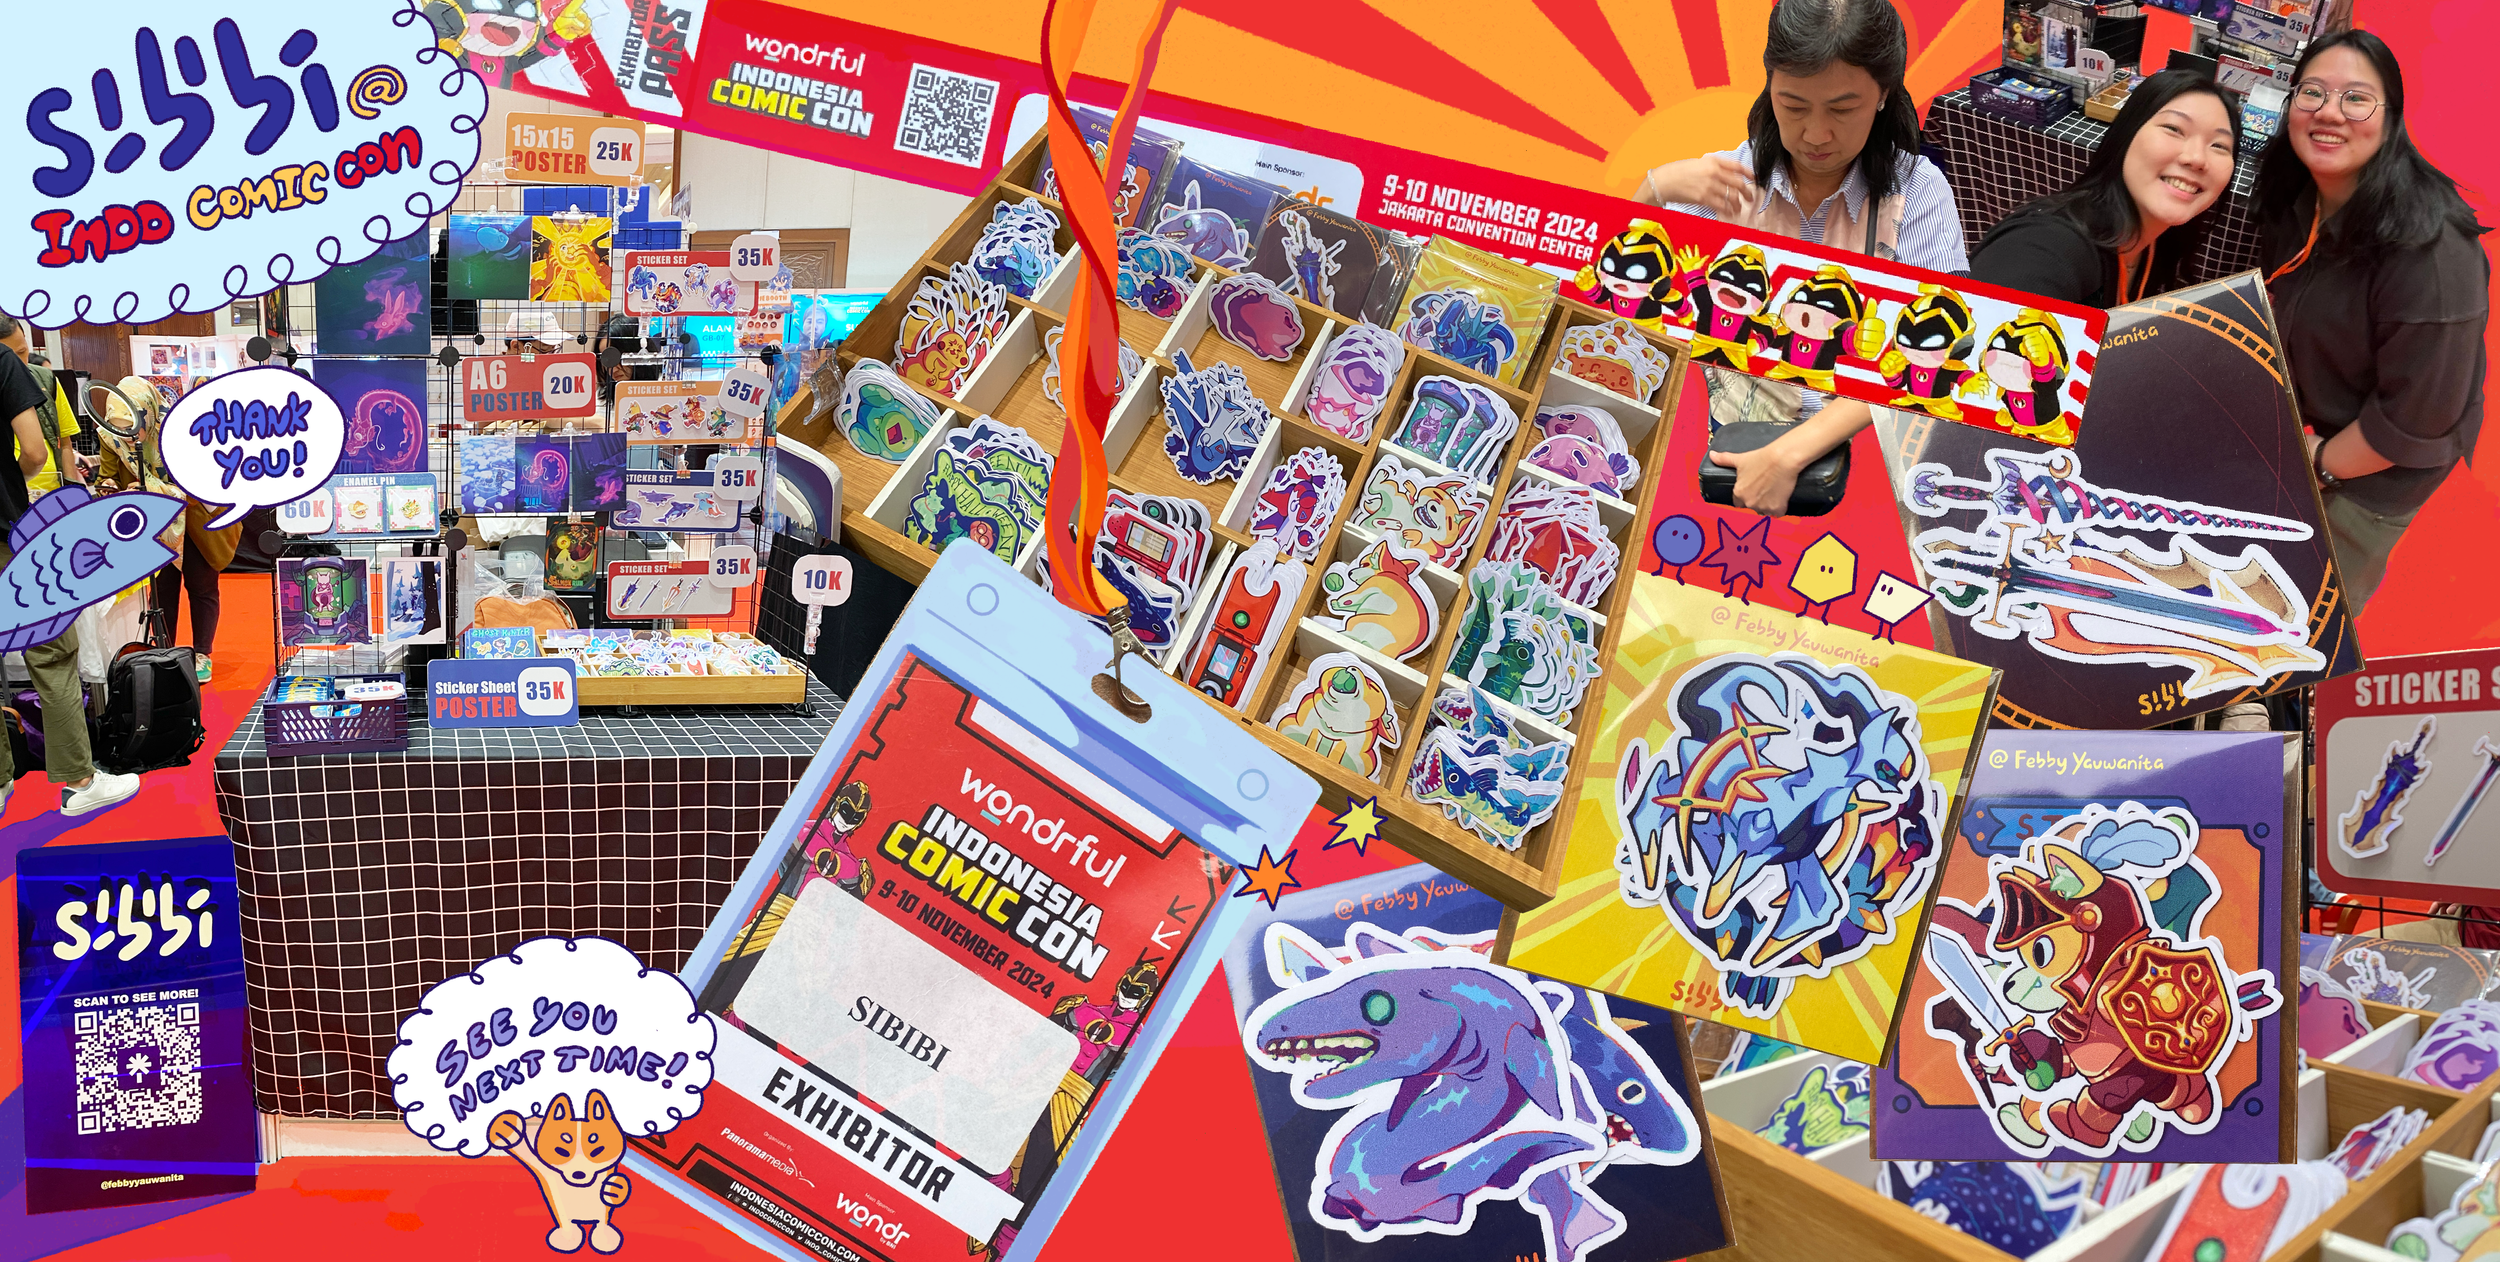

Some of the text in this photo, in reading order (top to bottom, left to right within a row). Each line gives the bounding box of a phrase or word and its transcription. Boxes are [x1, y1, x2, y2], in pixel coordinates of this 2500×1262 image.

[2289, 20, 2310, 34] 35K
[615, 0, 651, 89] EXHIBITOR
[639, 4, 692, 98] PASS
[745, 33, 866, 77] wondrful
[2082, 57, 2104, 71] 10K
[732, 62, 863, 110] INDONESIA
[2276, 70, 2293, 83] 35
[711, 78, 874, 137] COMIC CON
[511, 123, 575, 150] 15x15
[515, 150, 587, 175] POSTER
[596, 141, 633, 162] 25K
[1255, 160, 1305, 178] Main Sponsor:
[1383, 174, 1599, 243] 9-10 NOVEMBER 2024
[1378, 199, 1594, 262] JAKARTA CONVENTION CENTER
[637, 255, 688, 265] STICKER SET
[738, 248, 774, 267] 35K
[703, 325, 732, 333] ALAN
[470, 360, 507, 391] A6
[550, 375, 585, 395] 20K
[471, 391, 543, 413] POSTER
[628, 385, 678, 395] STICKER SET
[727, 378, 763, 406] 35K
[344, 476, 395, 486] ENAMEL PIN
[659, 474, 673, 483] SET
[722, 470, 756, 487] 35K
[943, 463, 963, 491] HAPPY
[284, 500, 325, 518] 60K
[620, 565, 668, 573] STICKER SET
[716, 558, 750, 575] 35K
[804, 569, 842, 591] 10K
[1710, 605, 1733, 625] @
[1735, 611, 1787, 648] Febby
[354, 685, 395, 693] 35K
[435, 681, 516, 695] Sticker Sheet
[526, 681, 566, 701] 35K
[2355, 668, 2481, 707] STICKER
[435, 696, 517, 719] POSTER
[1989, 749, 2165, 776] @ Febby Yauwanita
[960, 767, 1127, 888] wondrful
[923, 806, 1104, 939] INDONESIA
[883, 821, 1109, 982] COMIC CON
[1334, 899, 1354, 921] @
[1361, 888, 1418, 915] Febby
[878, 880, 1055, 999] 9-10 NOVEMBER 2024
[74, 988, 199, 1008] SCAN TO SEE MORE!
[847, 995, 951, 1073] SIBIBI
[762, 1066, 954, 1203] EXHIBITOR
[763, 1131, 787, 1149] Organized
[100, 1173, 184, 1190] @febbyyauwanita
[729, 1180, 861, 1262] INDONESIACOMICCON.COM
[748, 1203, 795, 1236] INDOCOMICCON
[836, 1192, 910, 1245] wondr
